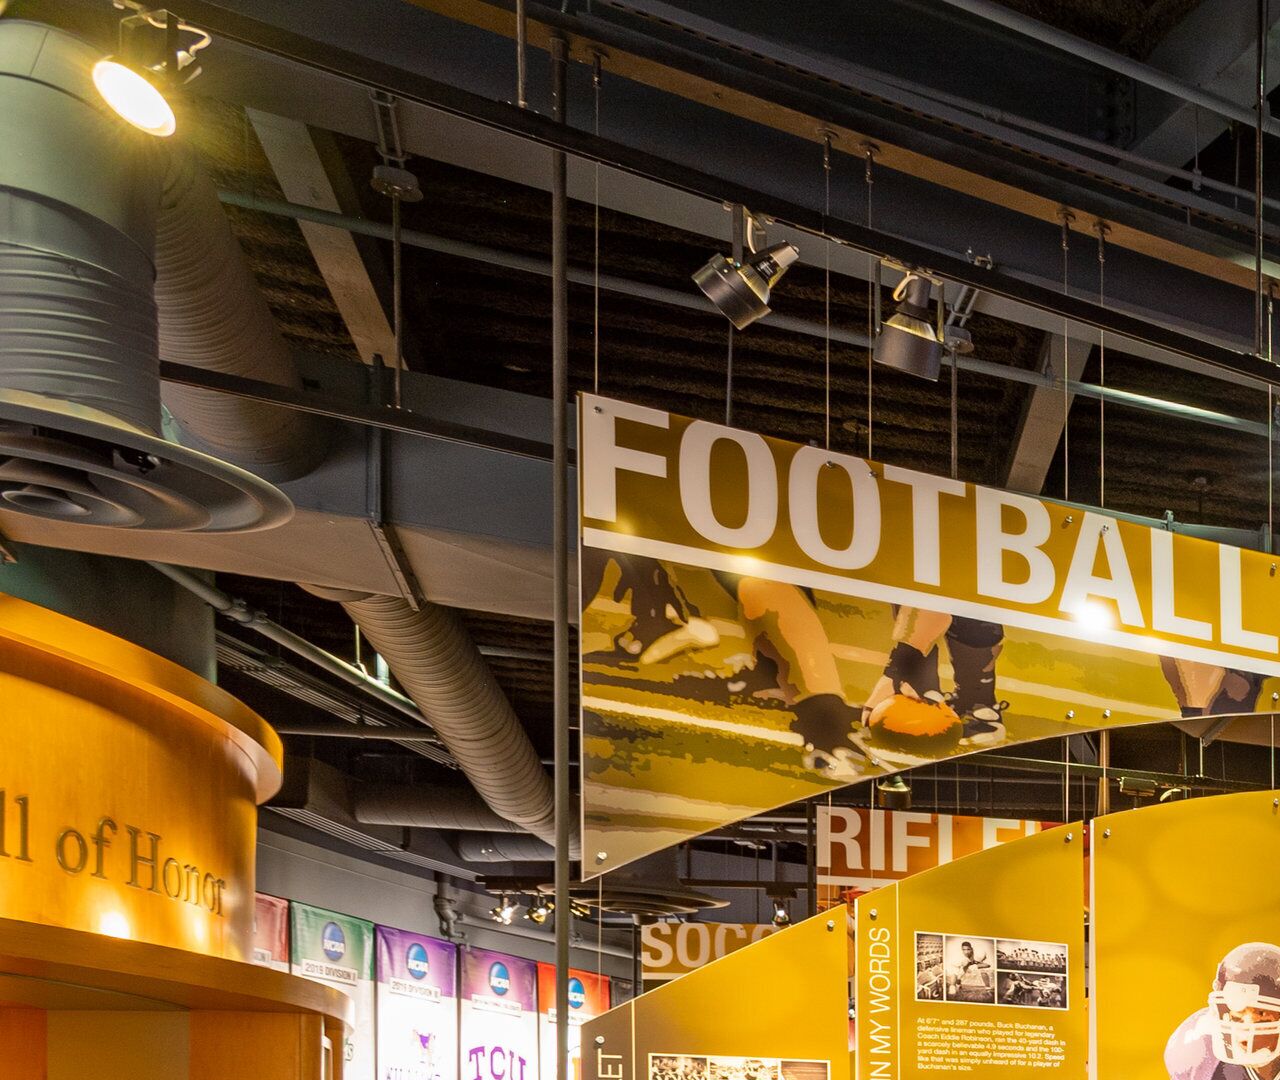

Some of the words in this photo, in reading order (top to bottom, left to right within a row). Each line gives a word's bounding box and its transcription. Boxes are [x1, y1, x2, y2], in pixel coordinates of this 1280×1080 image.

[582, 400, 1280, 655] FOOTBALL
[56, 816, 117, 879] of
[125, 824, 226, 917] Honor
[868, 927, 890, 1014] WORDS
[869, 1021, 891, 1054] MY
